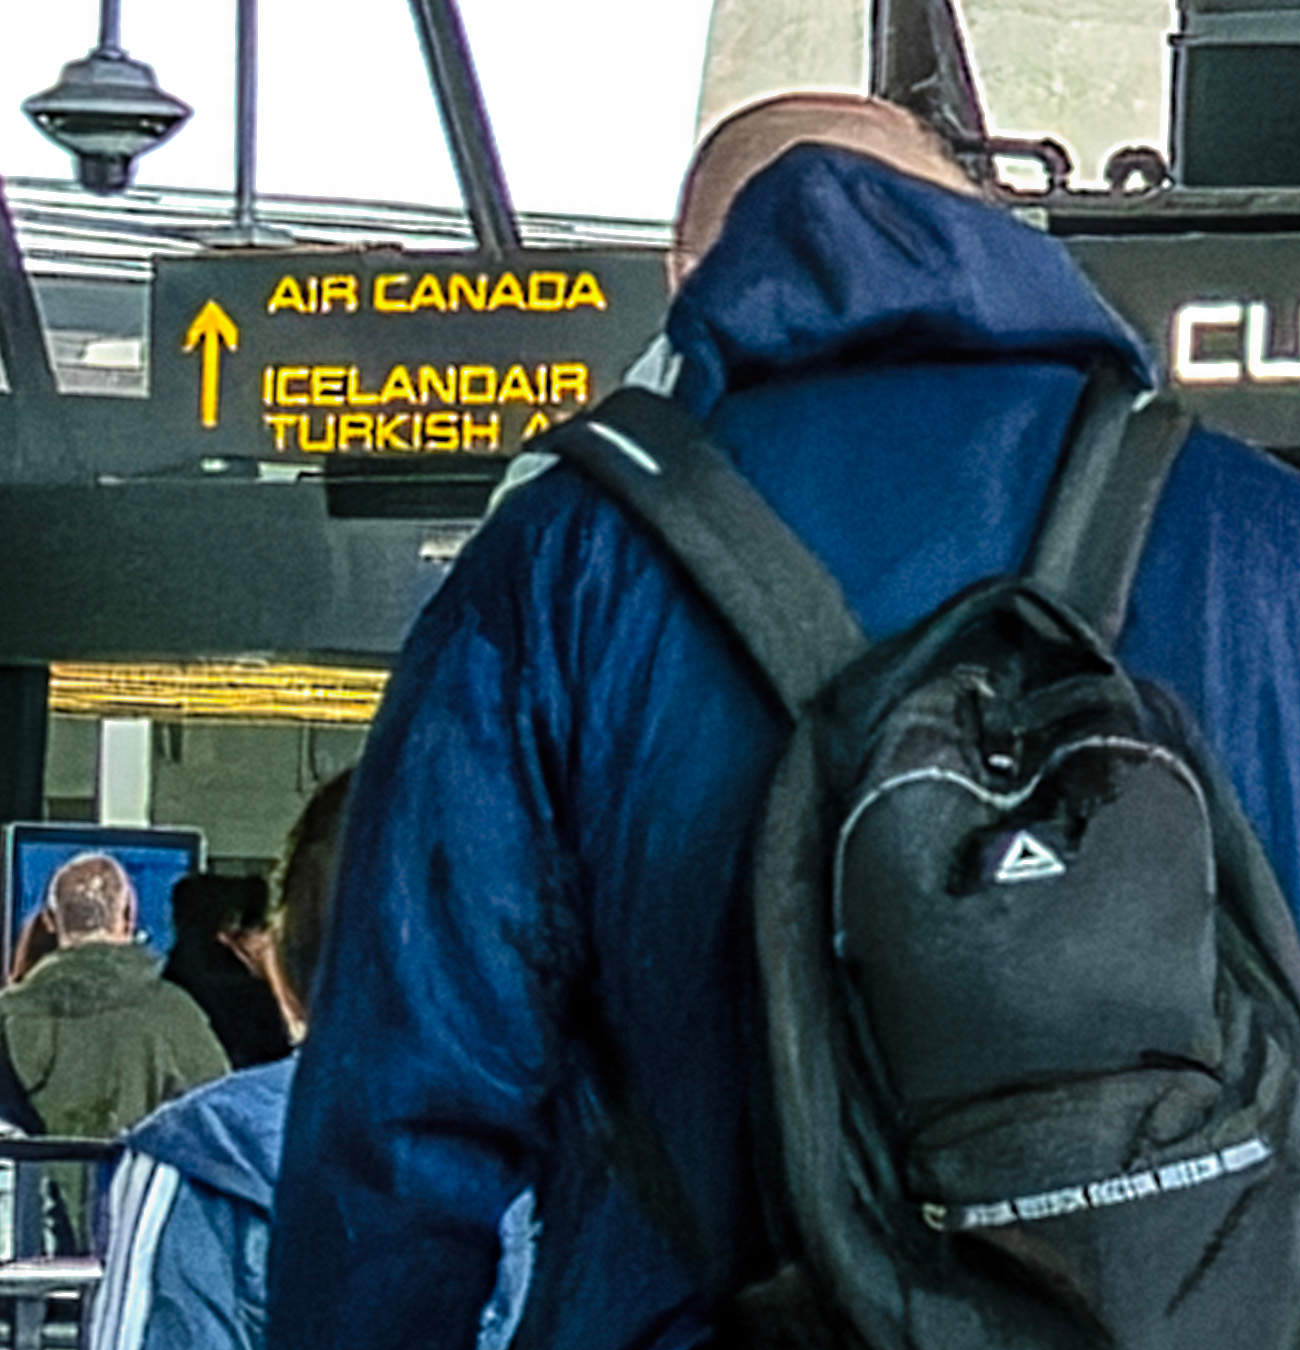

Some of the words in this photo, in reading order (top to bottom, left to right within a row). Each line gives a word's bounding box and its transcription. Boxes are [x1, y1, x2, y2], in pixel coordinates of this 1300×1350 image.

[267, 273, 359, 314] AIR
[373, 271, 608, 313] CANADA
[261, 362, 589, 408] ICELANDAIR
[263, 410, 501, 453] TURKISH
